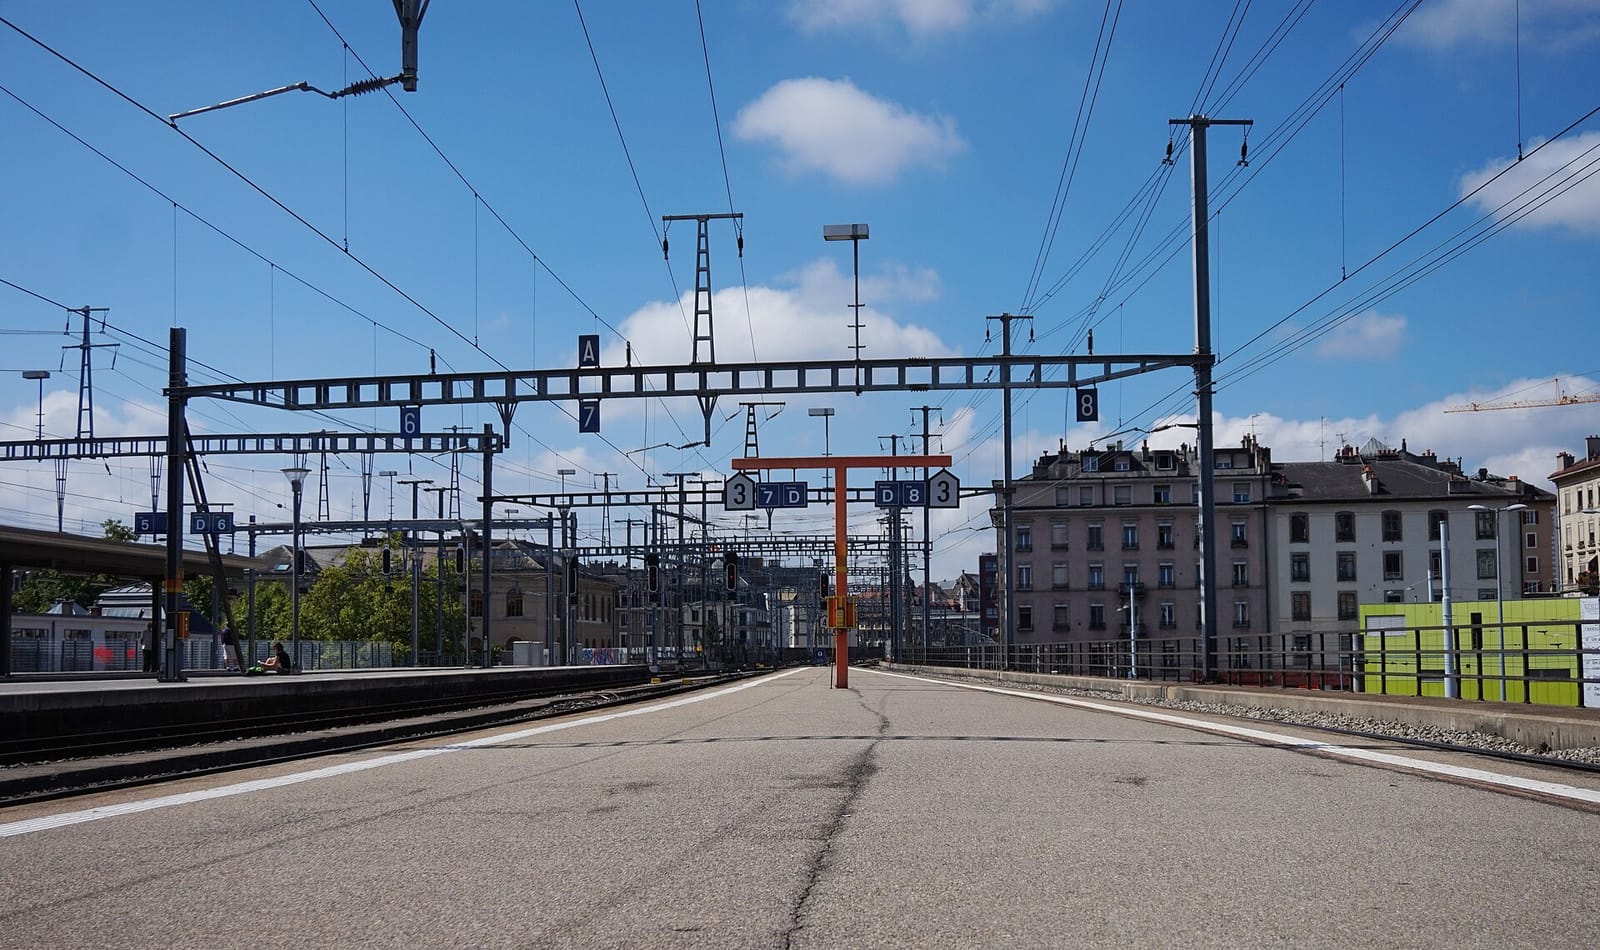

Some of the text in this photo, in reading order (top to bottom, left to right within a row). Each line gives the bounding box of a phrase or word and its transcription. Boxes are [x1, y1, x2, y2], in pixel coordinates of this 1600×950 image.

[583, 340, 595, 362] A
[1081, 394, 1093, 417] 8
[405, 412, 415, 434] 6
[583, 406, 595, 428] 7
[733, 483, 746, 505] 3
[763, 490, 800, 504] 7 D
[882, 488, 920, 503] D 8
[937, 480, 950, 502] 3
[141, 519, 149, 530] 5
[196, 519, 226, 530] D 6
